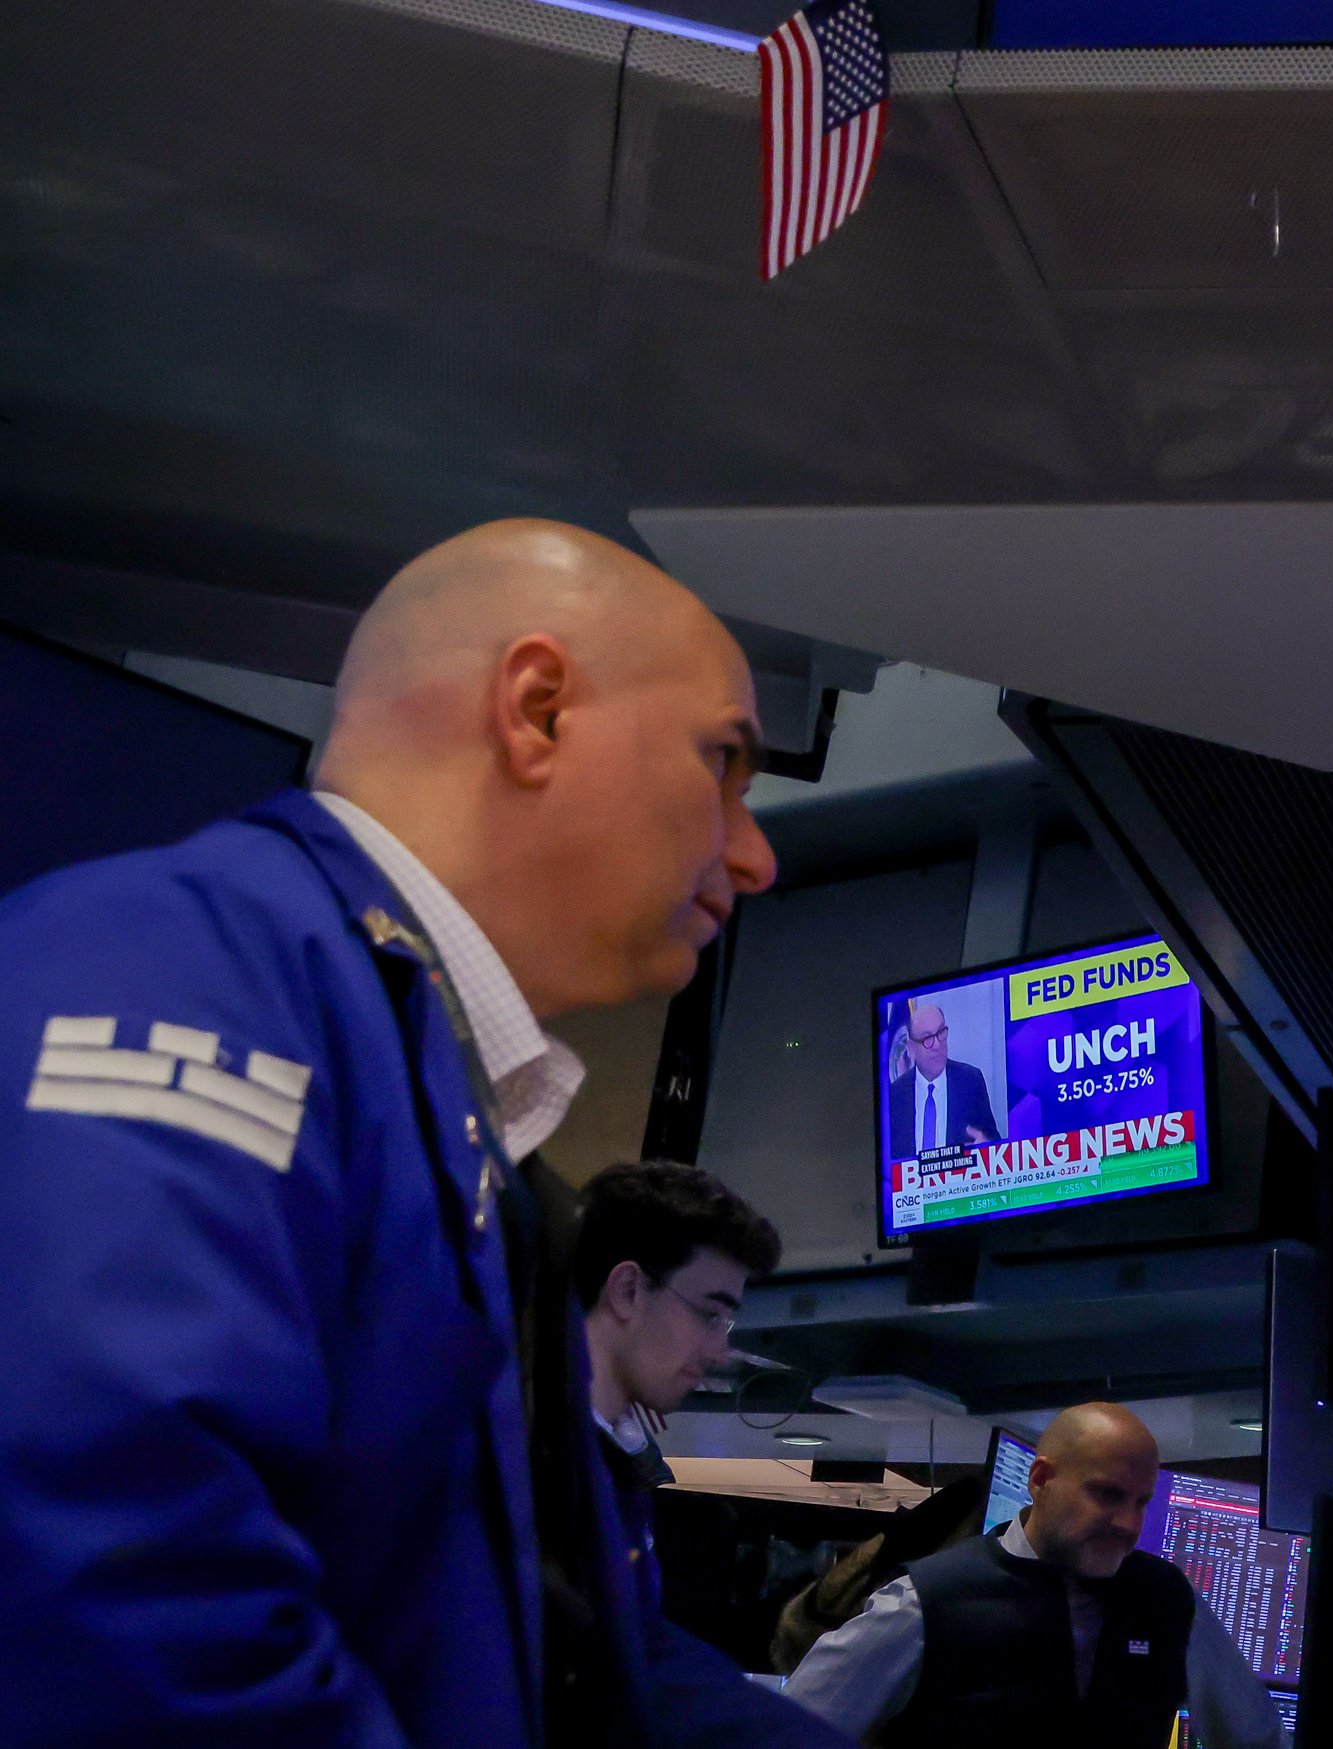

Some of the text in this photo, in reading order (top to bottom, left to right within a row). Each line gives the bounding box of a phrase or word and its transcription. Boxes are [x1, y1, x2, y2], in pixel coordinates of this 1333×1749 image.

[1027, 952, 1171, 1006] FED FUNDS
[1048, 1018, 1156, 1073] UNCH
[1057, 1067, 1154, 1102] 3.50-3.75%
[1080, 1111, 1185, 1159] NEWS
[921, 1162, 941, 1174] EXTENT
[949, 1185, 970, 1196] Active
[971, 1180, 996, 1191] Growth
[998, 1177, 1011, 1187] ETF
[1013, 1174, 1033, 1185] JGRO
[1035, 1170, 1055, 1181] 92.64
[1057, 1166, 1080, 1176] -0.257
[895, 1195, 920, 1208] CNBC
[1056, 1181, 1087, 1195] 4.255%
[969, 1198, 997, 1210] 3.581%
